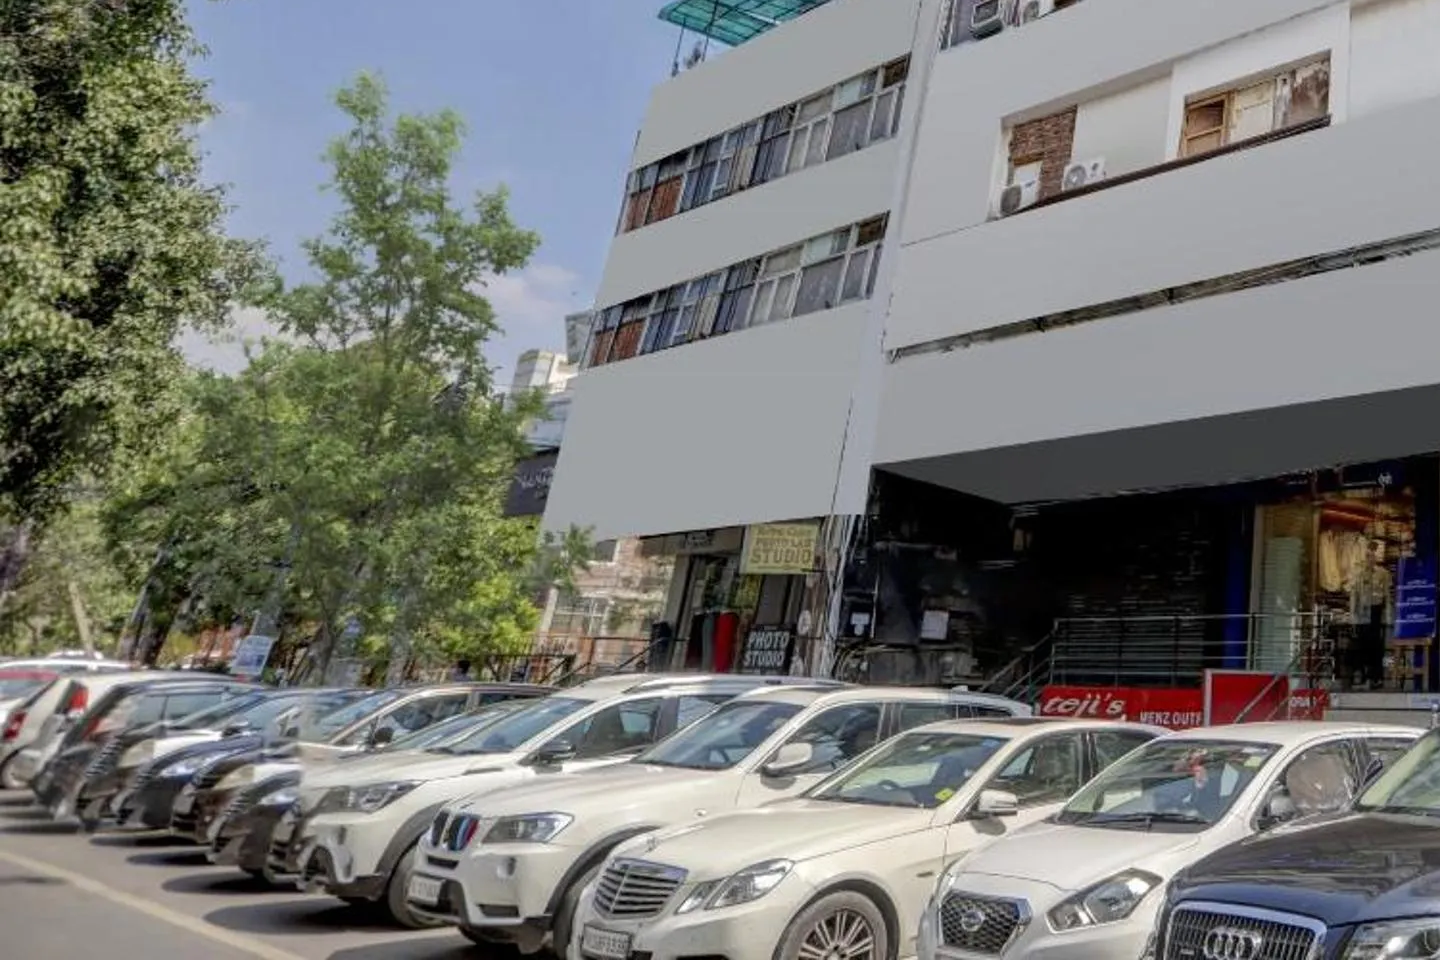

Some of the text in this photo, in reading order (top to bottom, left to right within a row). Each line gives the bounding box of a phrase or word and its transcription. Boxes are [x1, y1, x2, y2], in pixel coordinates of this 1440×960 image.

[750, 547, 811, 565] STUDIO
[747, 631, 790, 649] PHOTO
[743, 651, 785, 667] STUDIO
